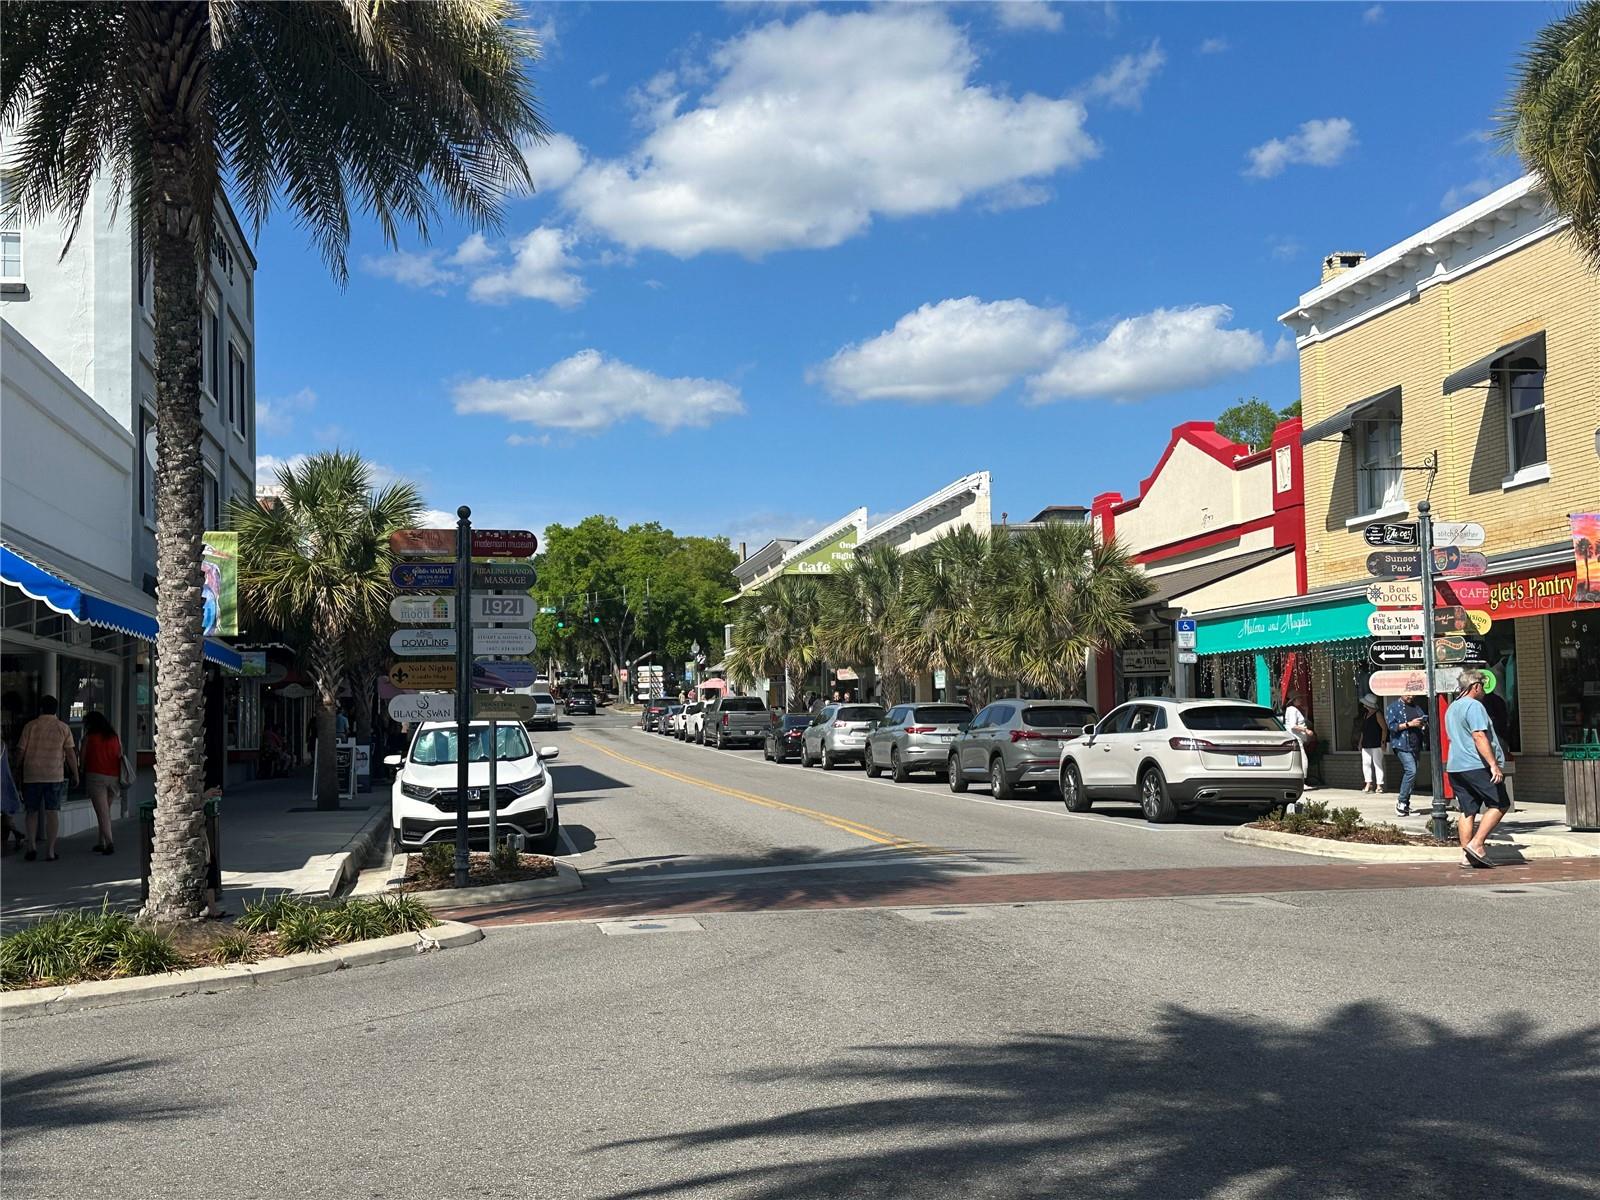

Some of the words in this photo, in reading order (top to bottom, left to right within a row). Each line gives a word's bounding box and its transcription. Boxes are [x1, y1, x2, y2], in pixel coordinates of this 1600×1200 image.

[475, 539, 507, 548] modernism
[839, 541, 856, 550] One
[831, 552, 855, 560] Flight
[476, 567, 507, 575] HEALING
[1389, 585, 1410, 593] Boat
[1460, 587, 1489, 598] CAFE
[1490, 581, 1524, 610] glet's
[1528, 575, 1575, 600] Pantry
[1382, 594, 1418, 602] DOCKS
[484, 600, 522, 615] 1921
[401, 639, 449, 648] DOWLING
[428, 664, 454, 673] Nights
[393, 709, 424, 719] BLACK
[426, 708, 451, 719] SWAN
